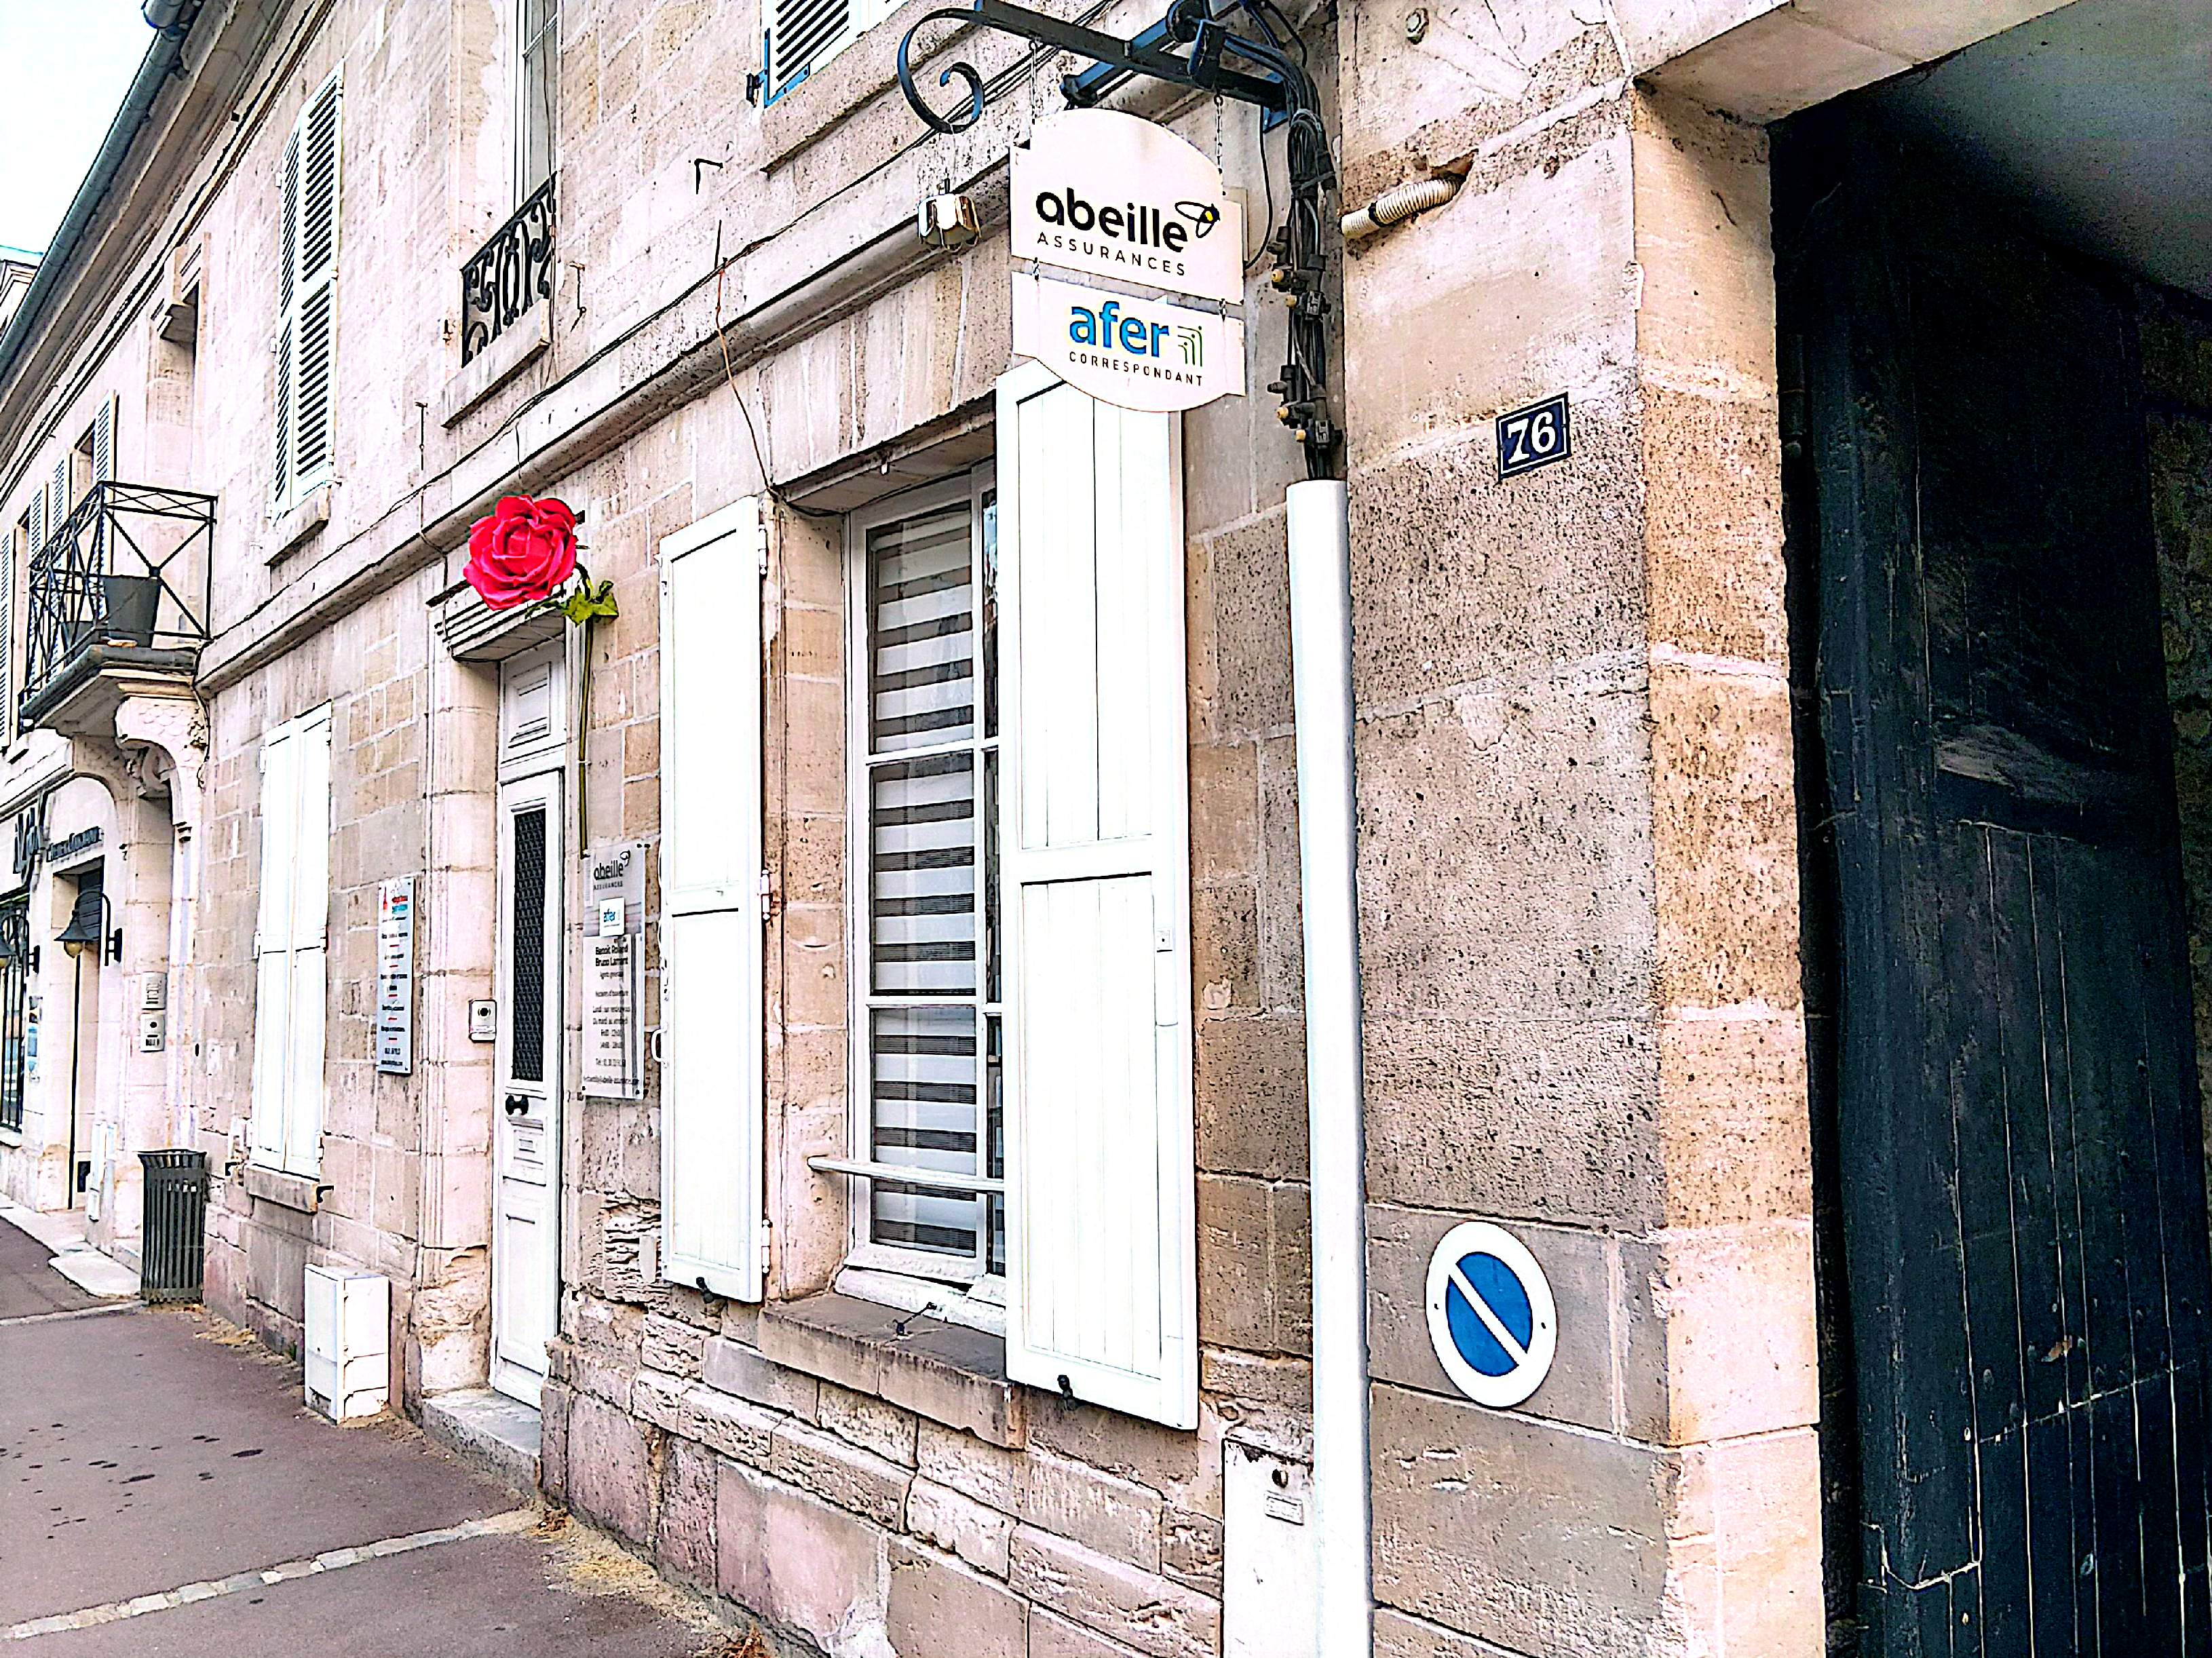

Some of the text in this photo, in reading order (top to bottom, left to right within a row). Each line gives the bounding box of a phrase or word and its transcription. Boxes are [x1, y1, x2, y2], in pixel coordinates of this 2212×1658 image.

[1035, 187, 1188, 252] abeille
[1037, 232, 1185, 277] ASSURANCES
[1069, 301, 1169, 358] afer
[1069, 351, 1203, 387] CORRESPONDANT
[1507, 411, 1556, 464] 76
[593, 860, 624, 881] abeille
